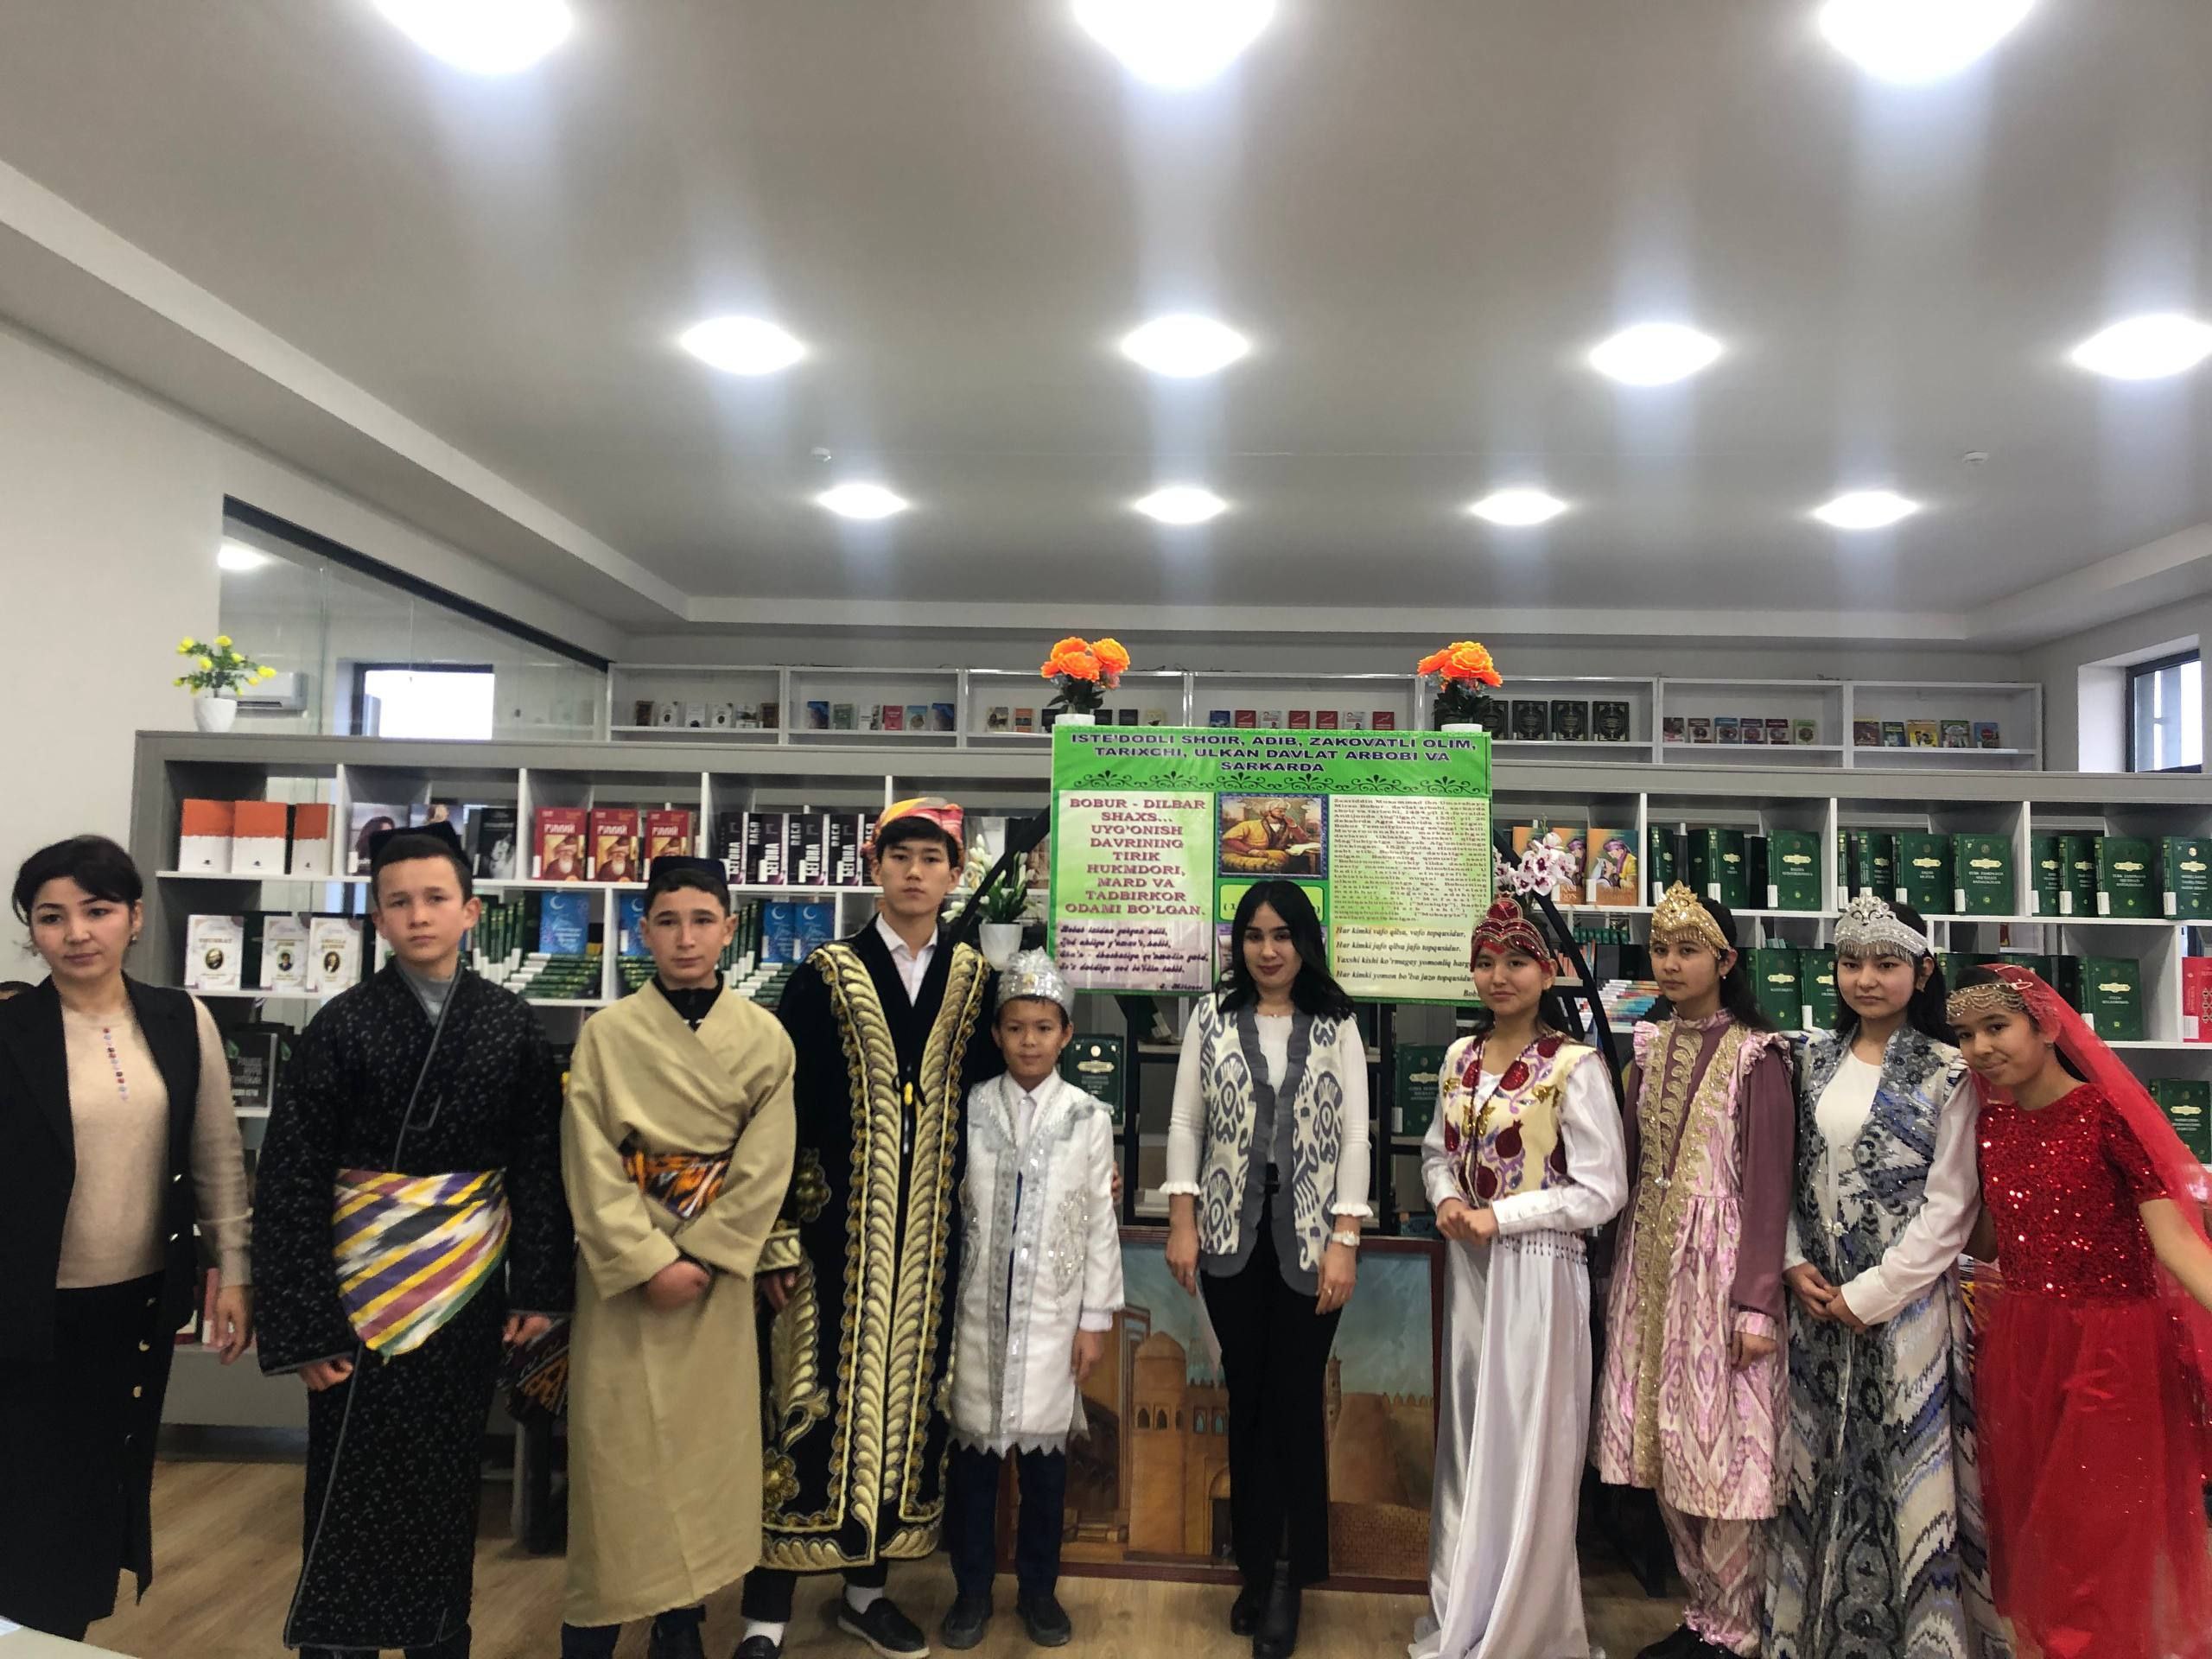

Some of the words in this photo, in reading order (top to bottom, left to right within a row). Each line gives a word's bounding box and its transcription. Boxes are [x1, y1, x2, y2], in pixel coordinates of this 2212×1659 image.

[1071, 734, 1174, 744] ISTE'DODLI
[1181, 734, 1244, 746] SHOIR,
[1252, 736, 1303, 747] ADIB,
[1309, 737, 1415, 747] ZAKOVATLI
[1422, 739, 1477, 750] OLIM,
[1095, 747, 1187, 758] TARIXCHI,
[1194, 748, 1259, 758] ULKAN
[1266, 749, 1338, 759] DAVLAT
[1344, 751, 1418, 760] ARBOBI
[1425, 752, 1451, 762] VA
[1220, 761, 1325, 772] SARKARDA
[1070, 798, 1128, 808] BOBUR
[1143, 799, 1205, 809] DILBAR
[1102, 811, 1173, 822] SHAXS...
[1090, 838, 1184, 849] DAVRINING
[1113, 851, 1160, 861] TIRIK
[1087, 864, 1185, 876] HUKMDORI,
[1097, 878, 1147, 887] MARD
[1153, 879, 1175, 887] VA
[1085, 891, 1186, 901] TADBIRKOR
[1065, 904, 1122, 913] ODAMI
[1128, 905, 1205, 915] BO'LGAN.
[1336, 926, 1351, 935] Har
[1351, 926, 1371, 935] kimki
[1336, 941, 1351, 950] Har
[1351, 941, 1371, 950] kimki
[1336, 969, 1351, 979] Har
[1351, 970, 1371, 979] kimki
